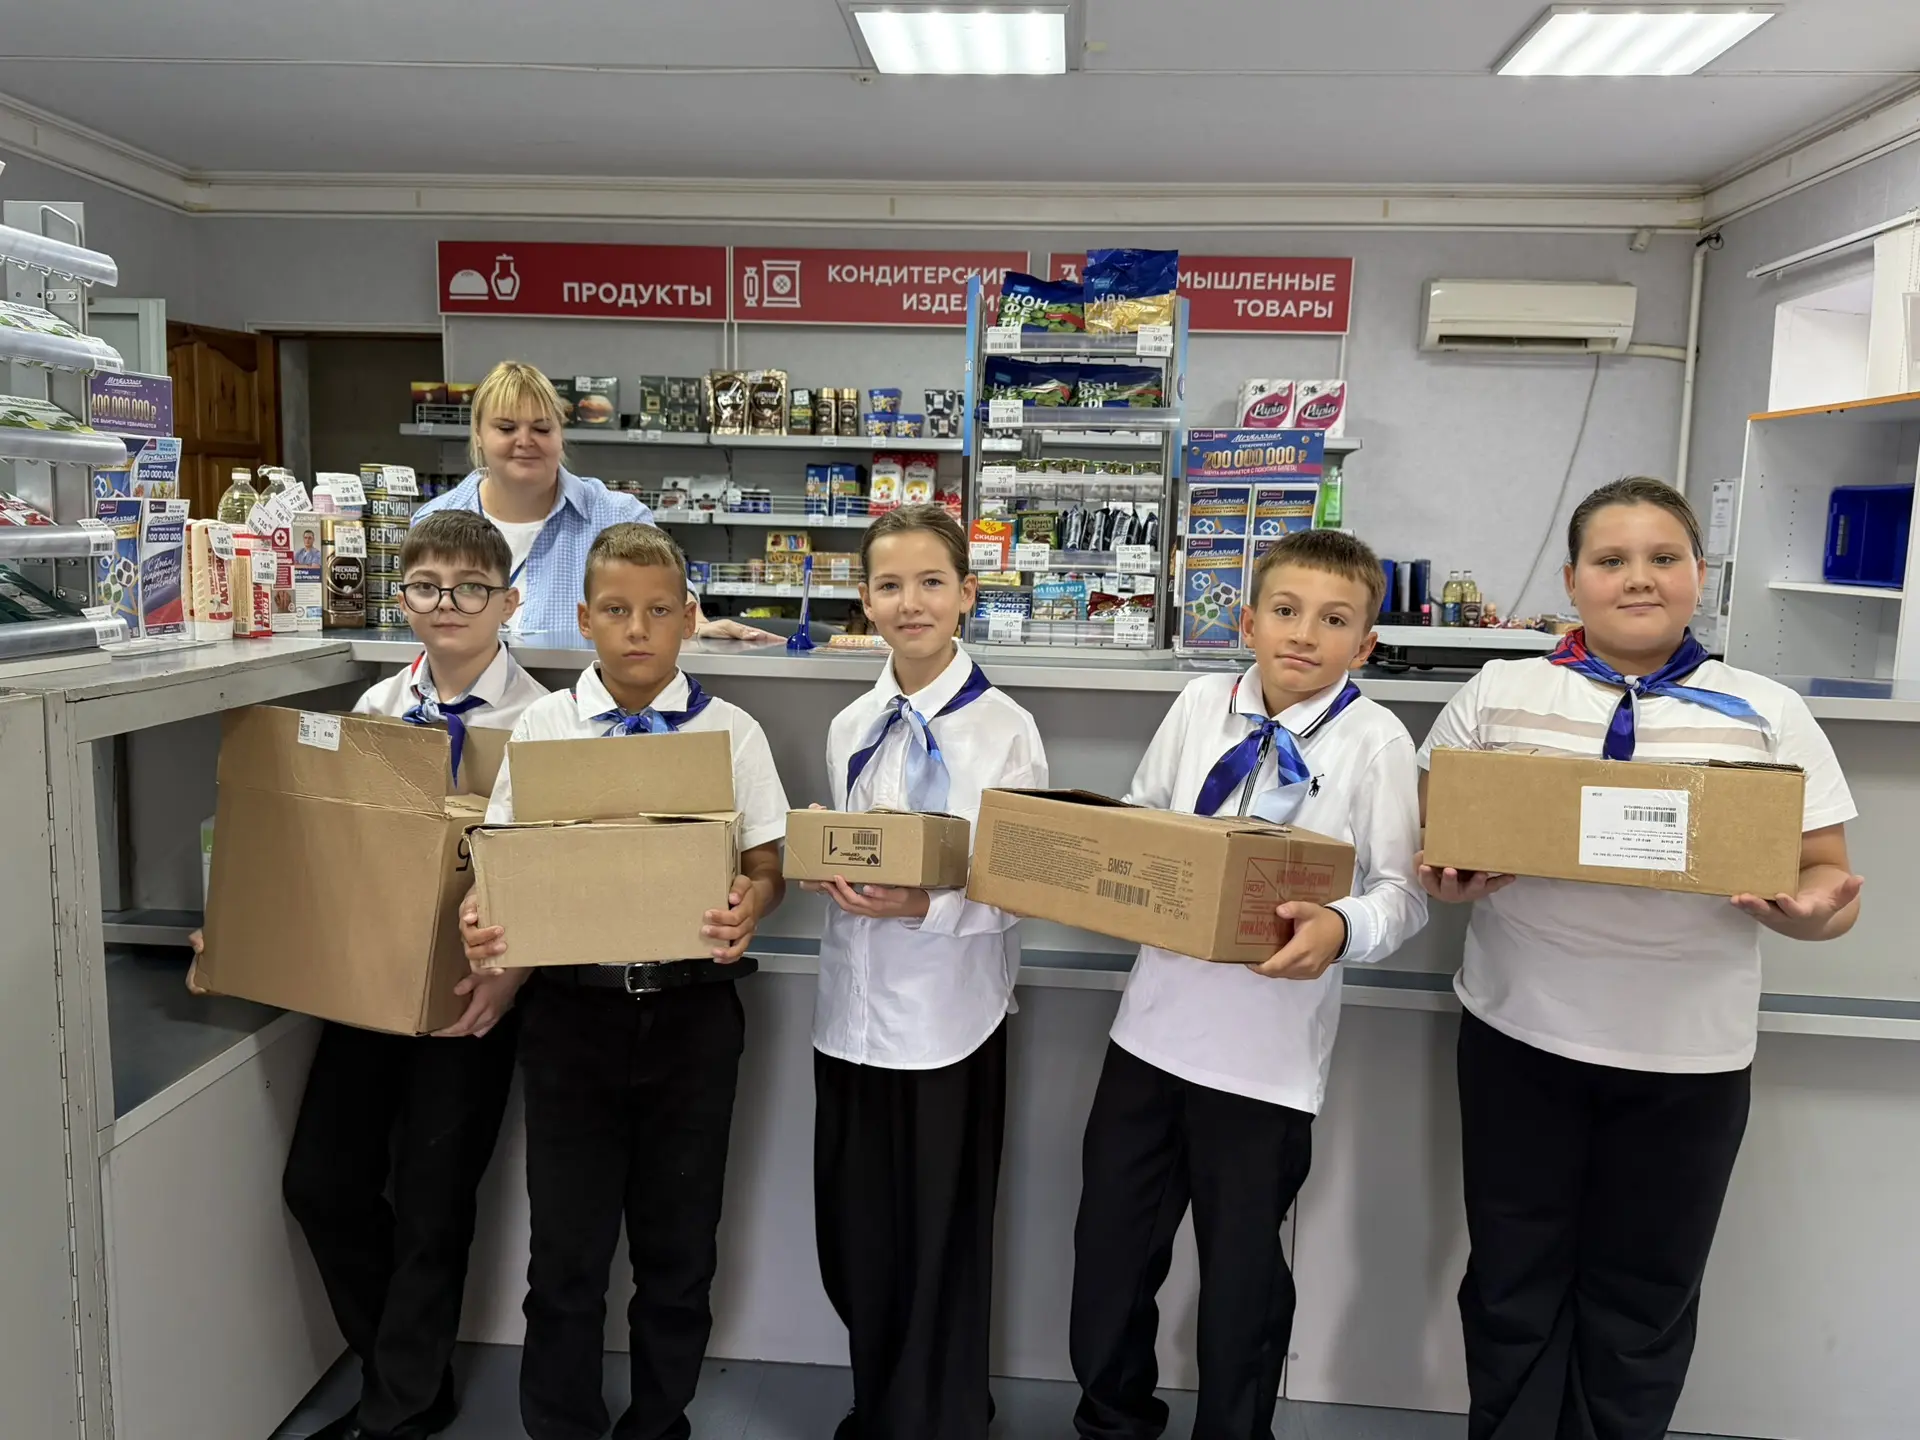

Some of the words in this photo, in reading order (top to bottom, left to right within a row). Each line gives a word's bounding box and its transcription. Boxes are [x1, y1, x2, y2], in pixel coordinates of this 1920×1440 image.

[828, 264, 1012, 287] КОНДИТЕРСКИЕ
[1176, 271, 1336, 292] МЫШЛЕННЫЕ
[563, 282, 712, 308] ПРОДУКТЫ
[902, 293, 1001, 313] ИЗДЕИ
[1007, 292, 1050, 310] КОН
[1004, 302, 1034, 318] ФЕ
[1234, 299, 1334, 318] ТОВАРЫ
[1254, 402, 1286, 418] Papia
[1305, 402, 1338, 418] Papia
[1202, 450, 1232, 470] 200
[1234, 448, 1264, 468] 000
[1266, 445, 1296, 466] 000
[216, 557, 230, 606] АКТИВИ
[253, 583, 263, 626] ИВИСТ
[380, 608, 405, 623] ВЕТЧ
